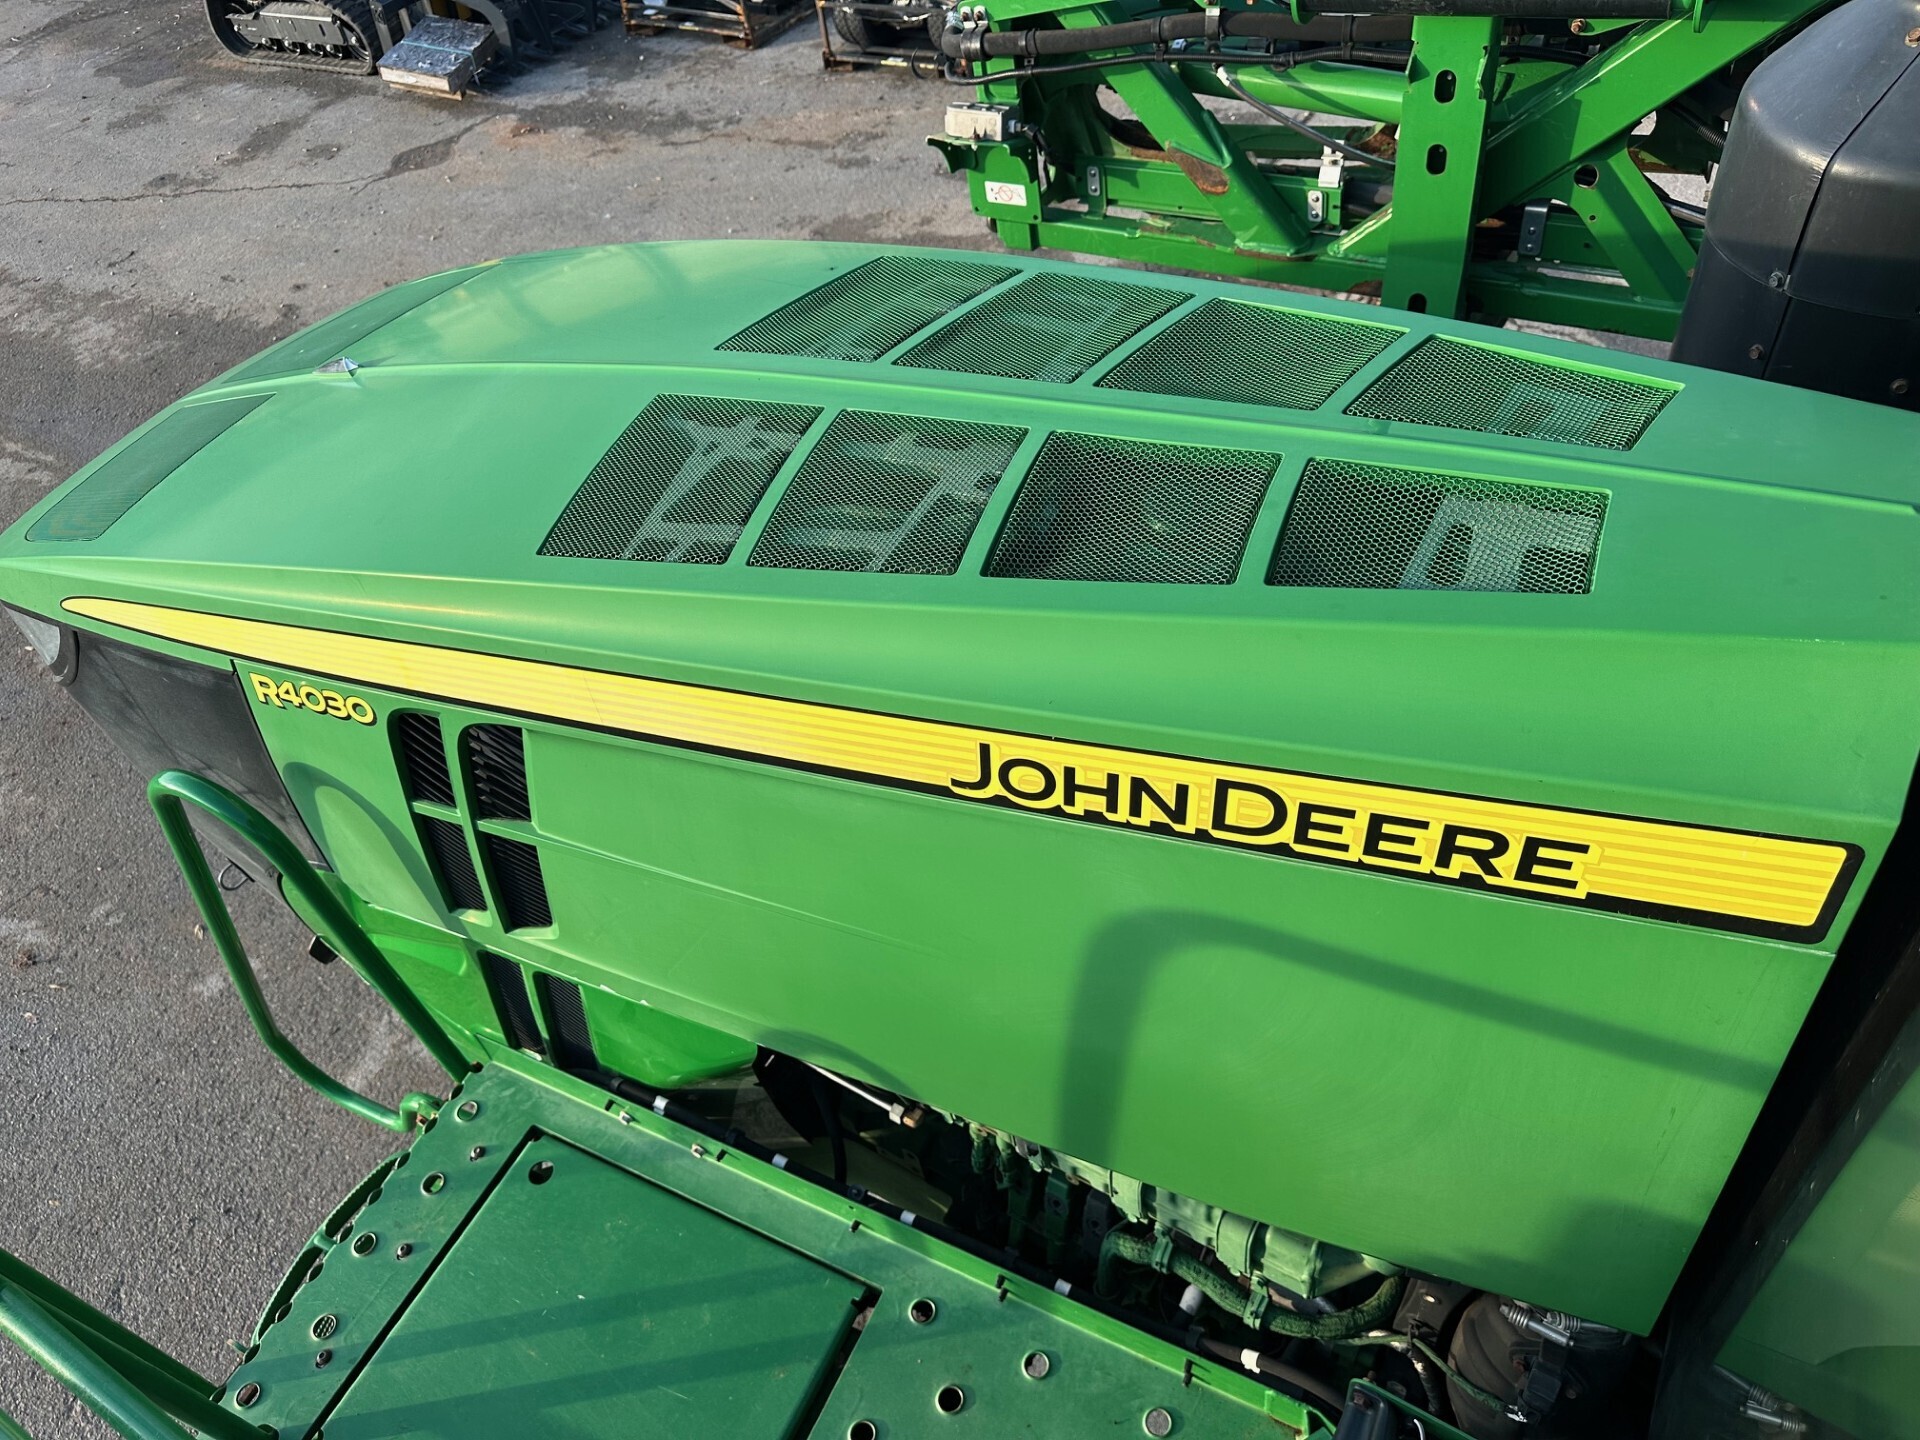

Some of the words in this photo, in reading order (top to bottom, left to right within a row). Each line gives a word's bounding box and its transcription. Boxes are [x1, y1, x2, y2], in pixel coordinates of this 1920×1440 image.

[249, 672, 376, 725] R4030
[950, 743, 1192, 829] JOHN
[1210, 777, 1592, 892] DEERE
